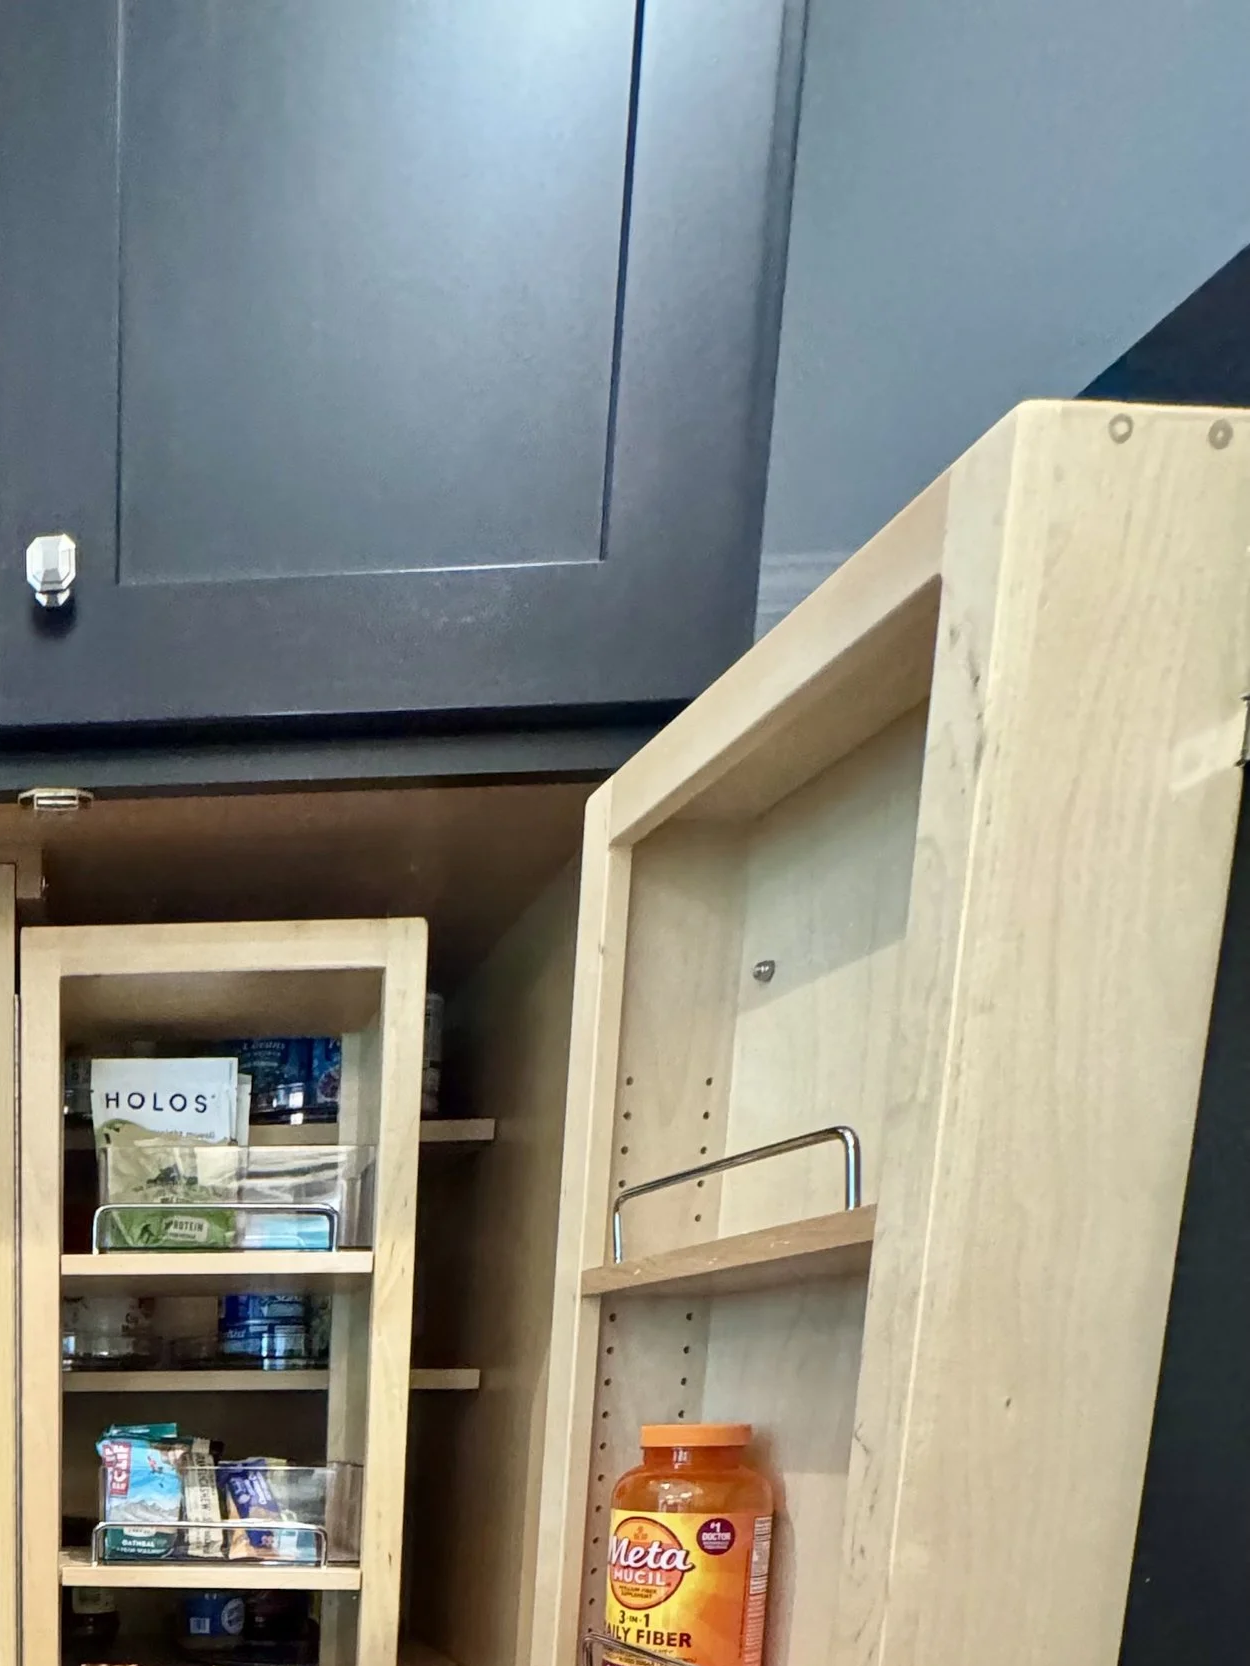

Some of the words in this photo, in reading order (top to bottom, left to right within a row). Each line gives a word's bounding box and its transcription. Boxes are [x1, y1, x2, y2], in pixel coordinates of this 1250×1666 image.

[105, 1092, 208, 1113] HOLOS
[609, 1535, 695, 1571] Meta
[614, 1568, 666, 1586] MUCIL
[605, 1621, 630, 1642] AILY
[636, 1629, 691, 1648] FIBER
